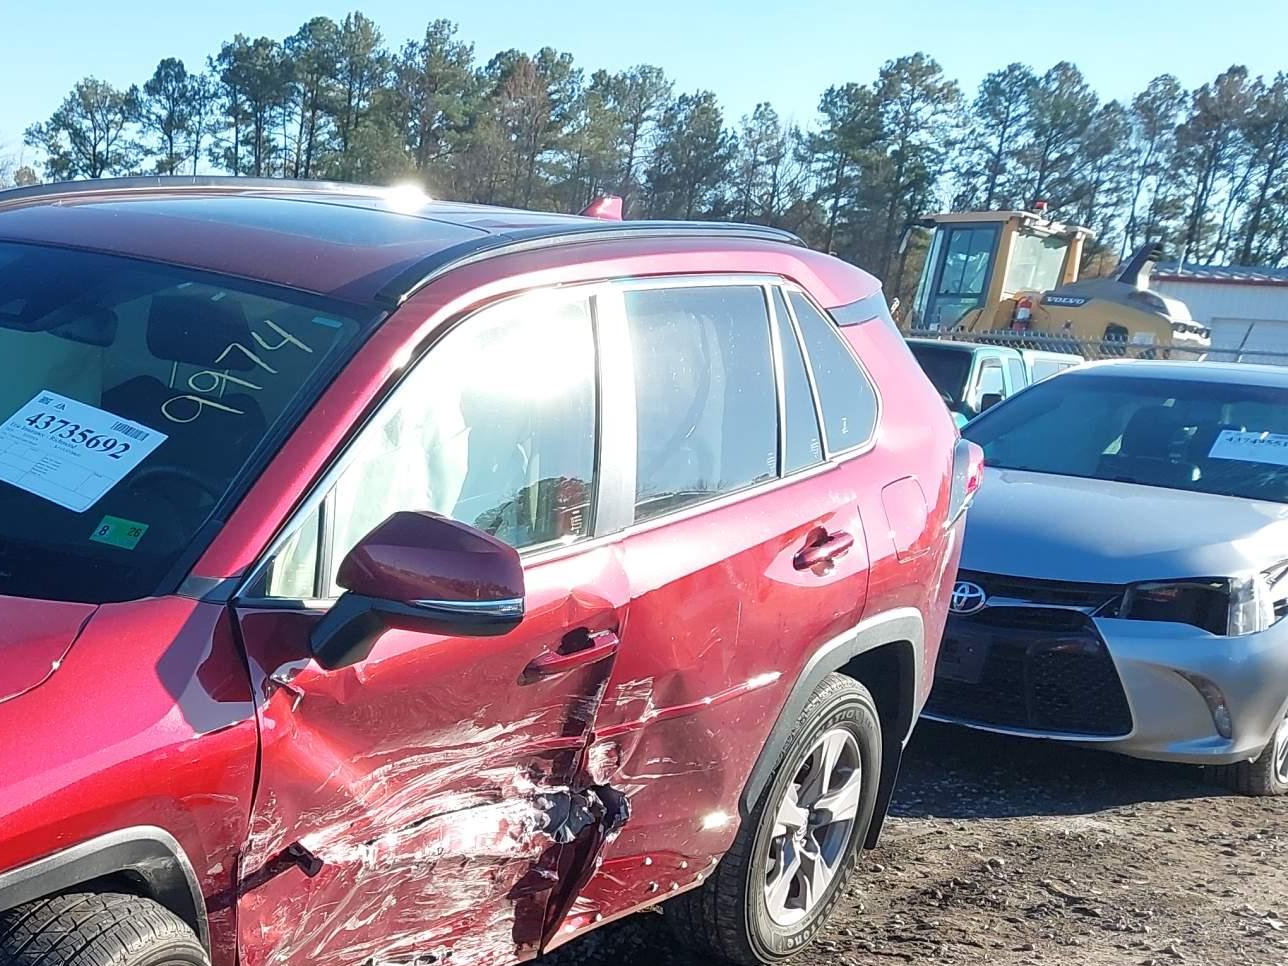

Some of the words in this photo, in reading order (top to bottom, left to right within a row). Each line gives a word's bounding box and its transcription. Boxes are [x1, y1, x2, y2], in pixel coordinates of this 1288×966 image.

[161, 319, 313, 423] 9974
[25, 412, 131, 460] 43735692
[98, 524, 110, 536] 8
[128, 527, 142, 537] 26
